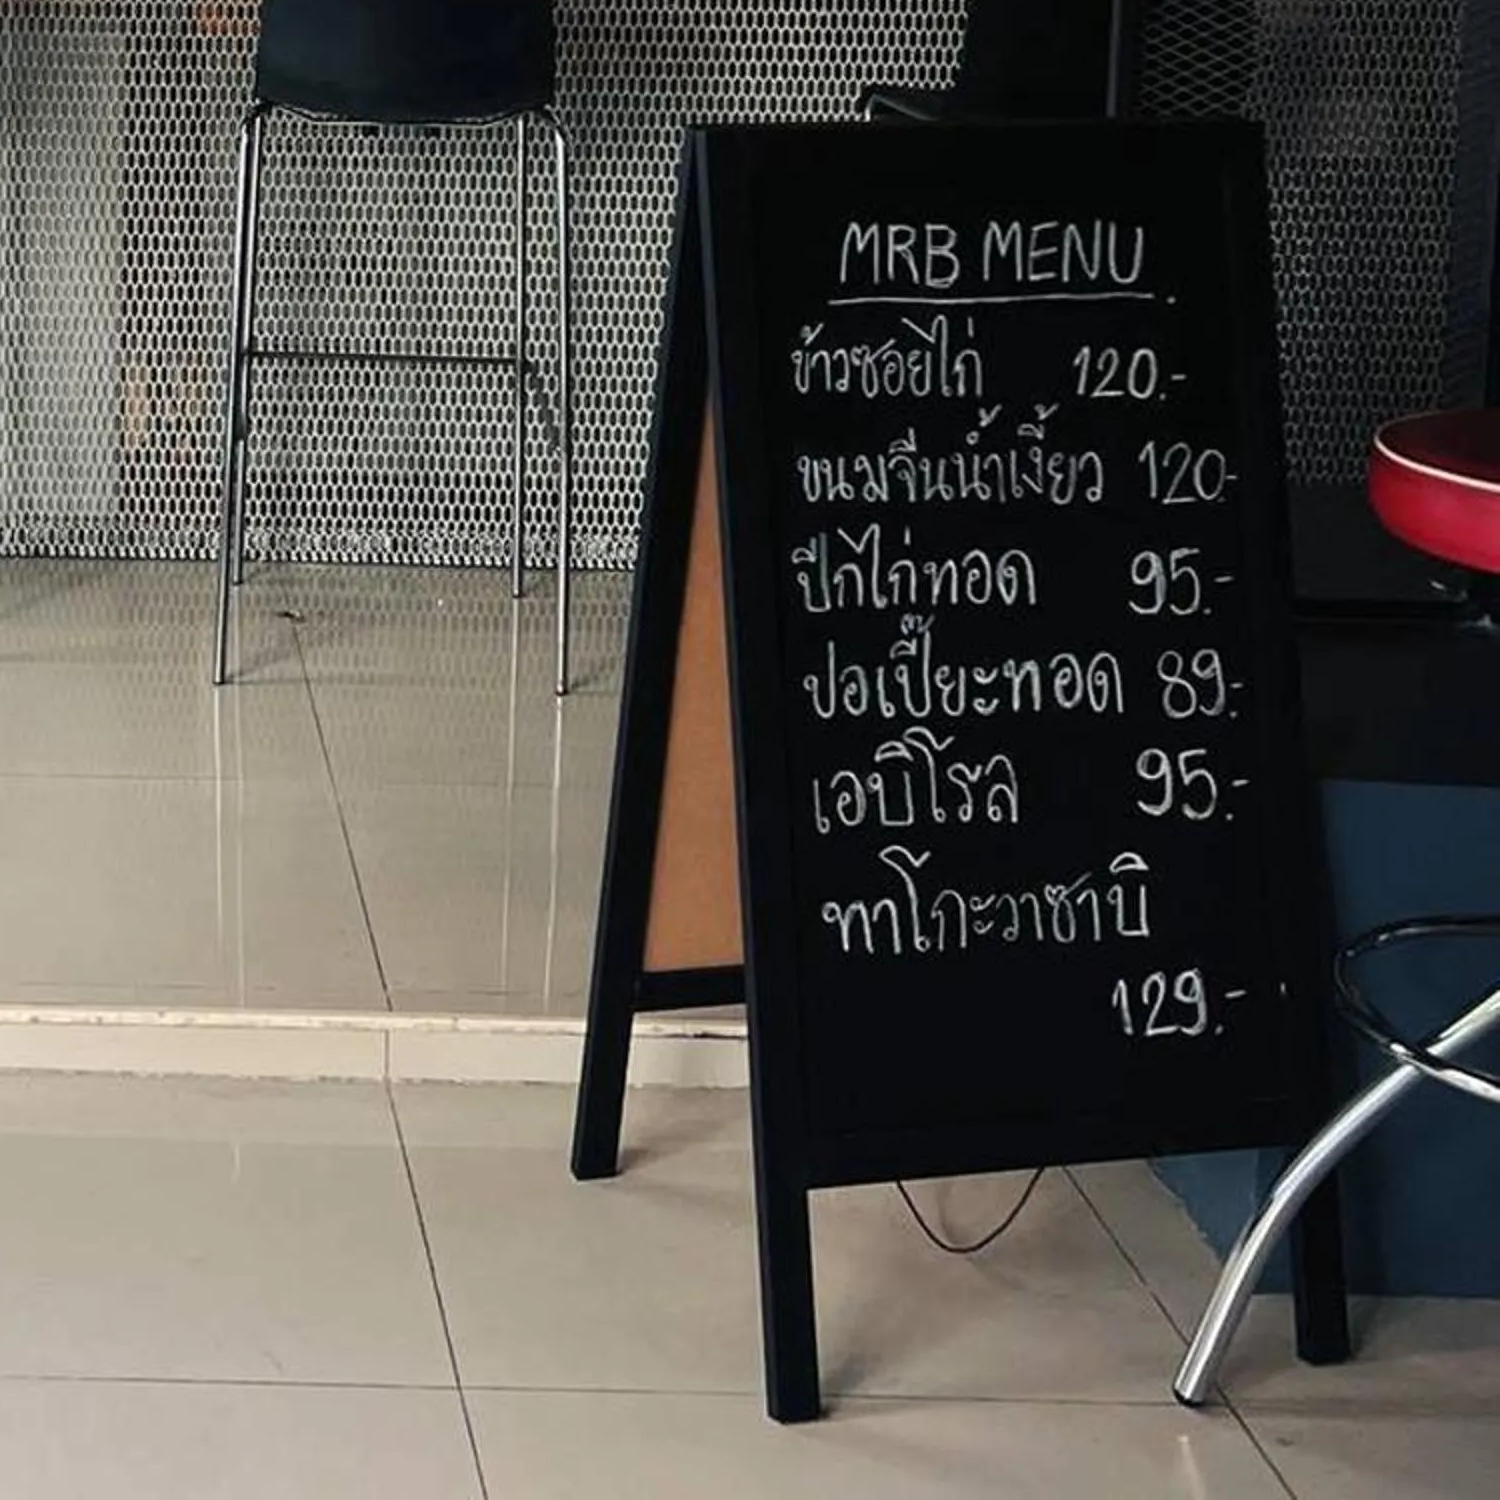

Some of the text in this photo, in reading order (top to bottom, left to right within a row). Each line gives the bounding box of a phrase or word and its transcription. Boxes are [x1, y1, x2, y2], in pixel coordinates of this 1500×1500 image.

[840, 220, 1144, 288] MRB MENU
[791, 315, 1187, 400] ข้าวซอยไก่ 120.-
[791, 524, 1234, 615] ปีกไก่ทอด 95.-
[813, 726, 1250, 834] เอบิโรล 95.-
[1111, 967, 1246, 1037] 129.-
